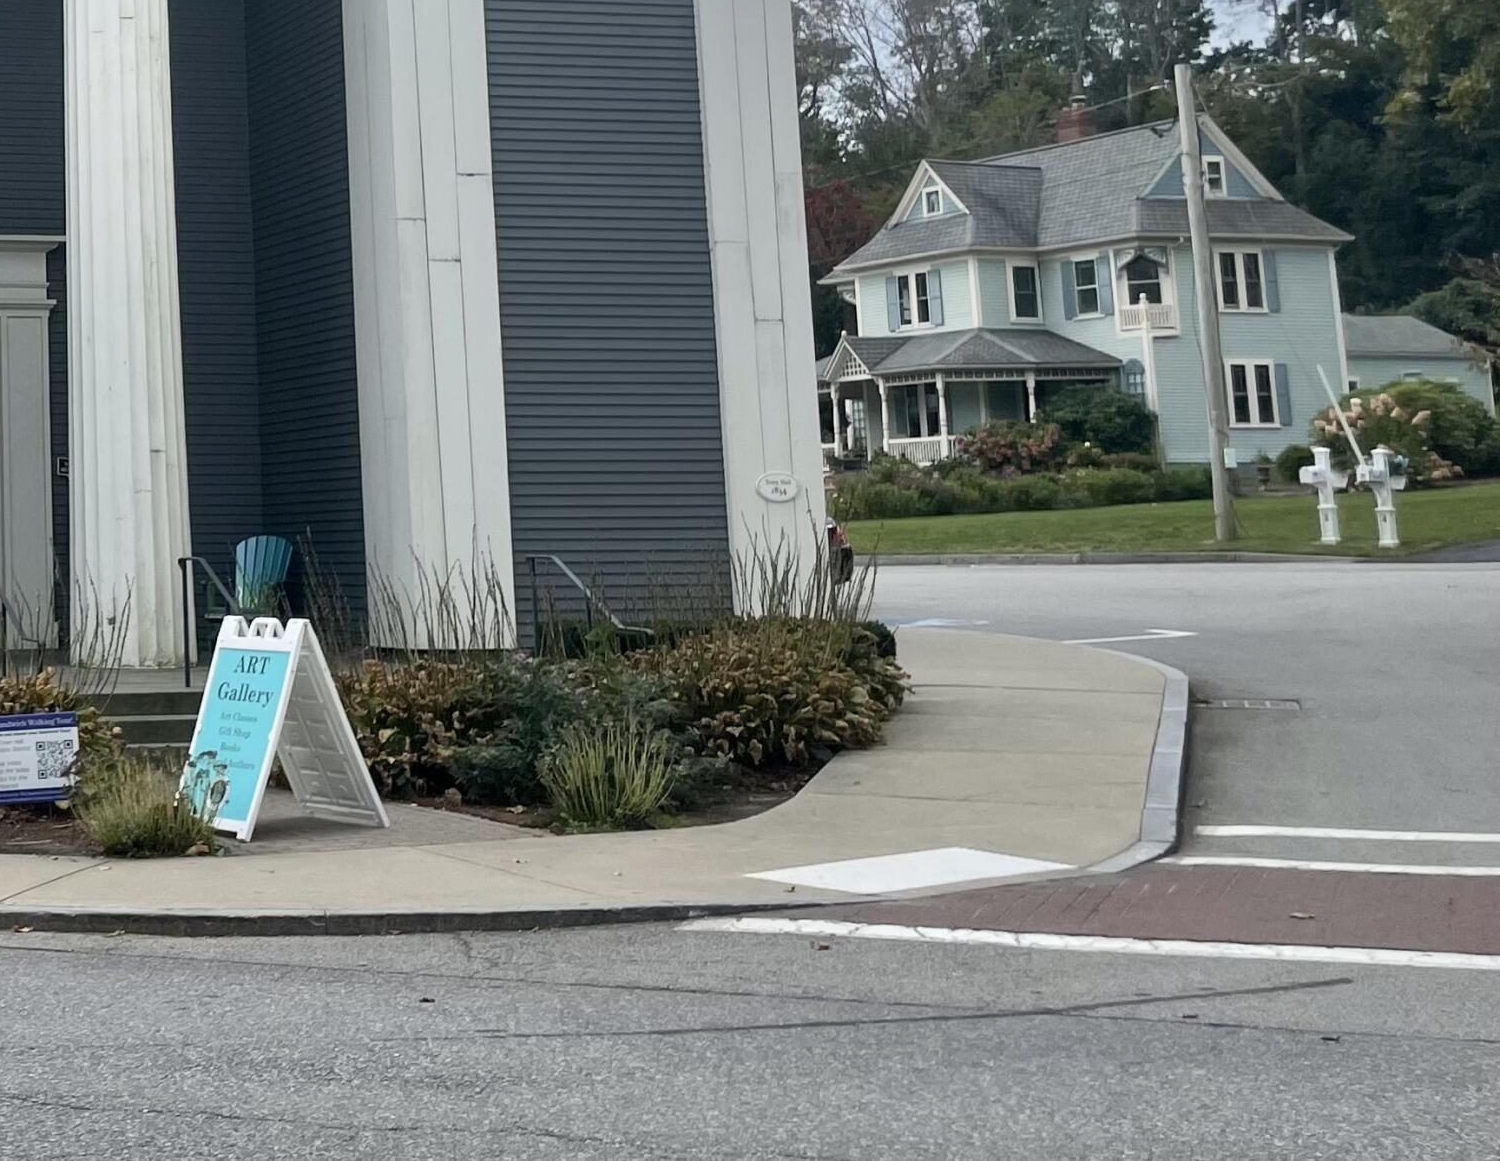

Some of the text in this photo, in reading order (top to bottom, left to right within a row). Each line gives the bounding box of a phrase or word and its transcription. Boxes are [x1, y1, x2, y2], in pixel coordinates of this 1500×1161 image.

[233, 654, 271, 675] ART
[217, 681, 275, 709] Gallery
[27, 718, 56, 727] Walking
[56, 717, 74, 725] Tour
